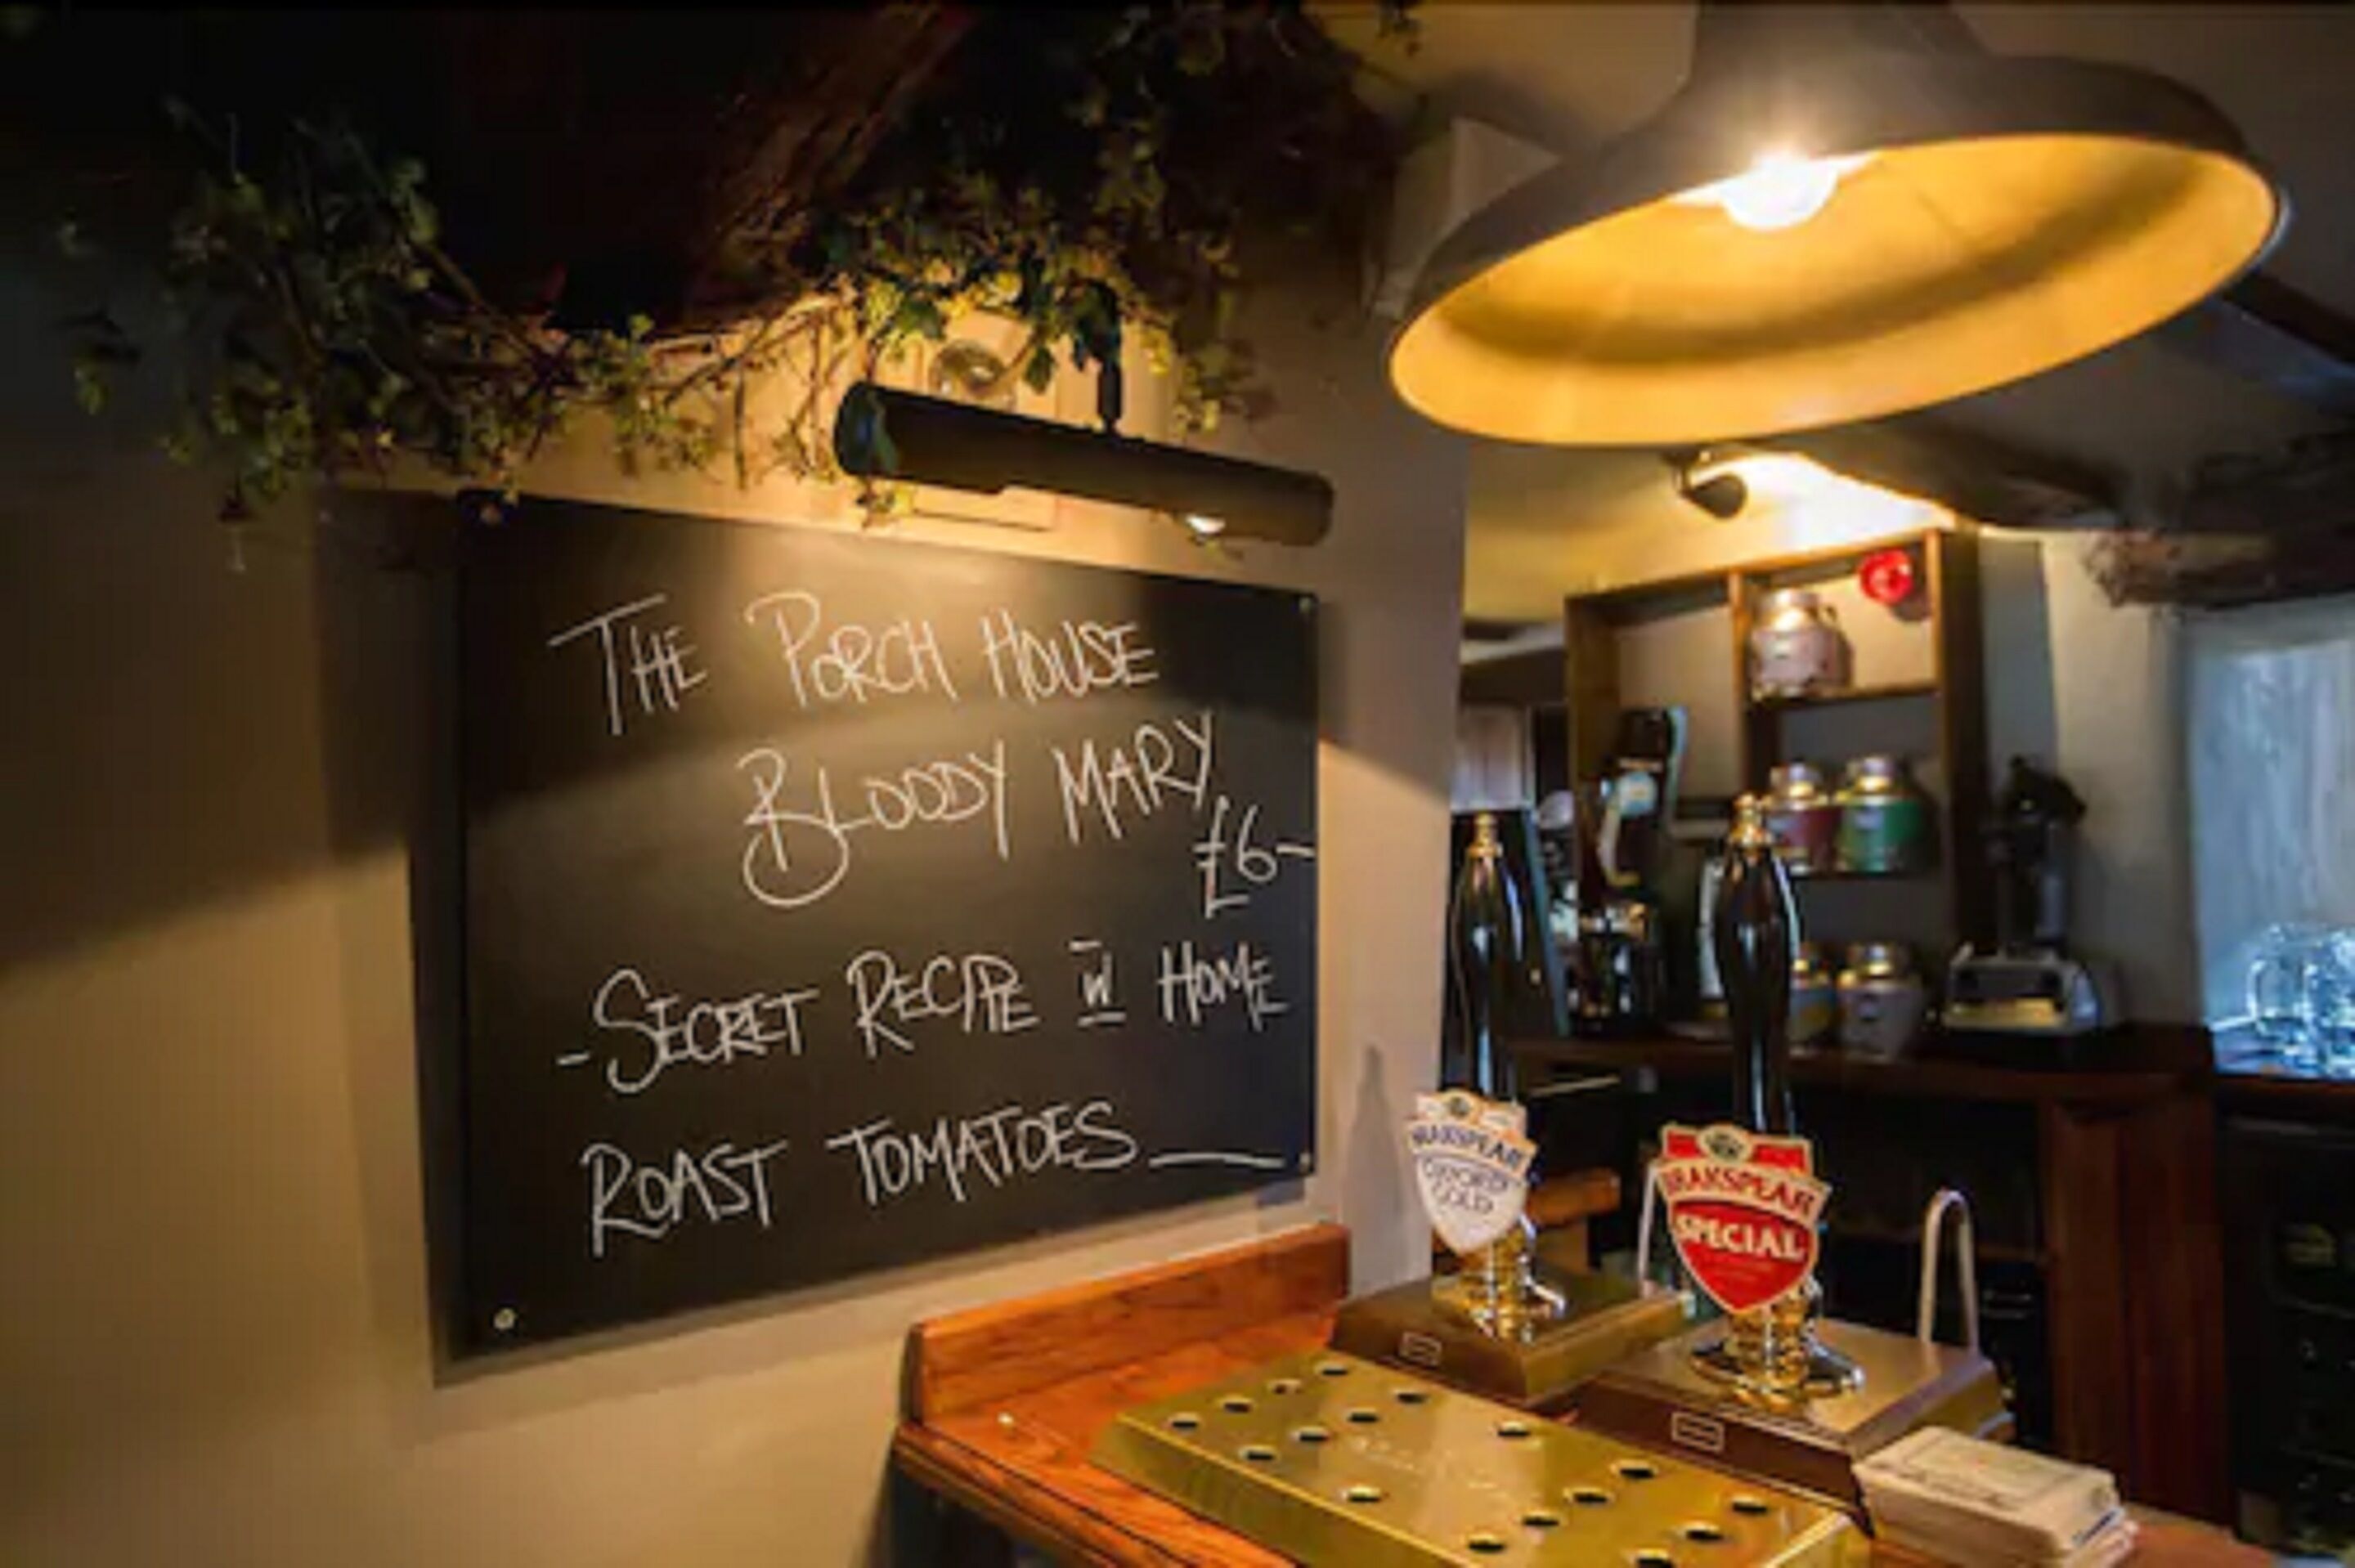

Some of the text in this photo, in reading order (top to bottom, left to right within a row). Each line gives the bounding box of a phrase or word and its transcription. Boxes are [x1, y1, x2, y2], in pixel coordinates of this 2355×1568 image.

[546, 591, 1160, 736] THE PORCH HOUSE
[733, 710, 1213, 909] BLOODY MARY
[846, 951, 1041, 1059] RECIPE
[1155, 940, 1289, 1032] HOME
[578, 1100, 1139, 1258] ROAST TOMATOES
[1676, 1214, 1806, 1263] SPECIAL
